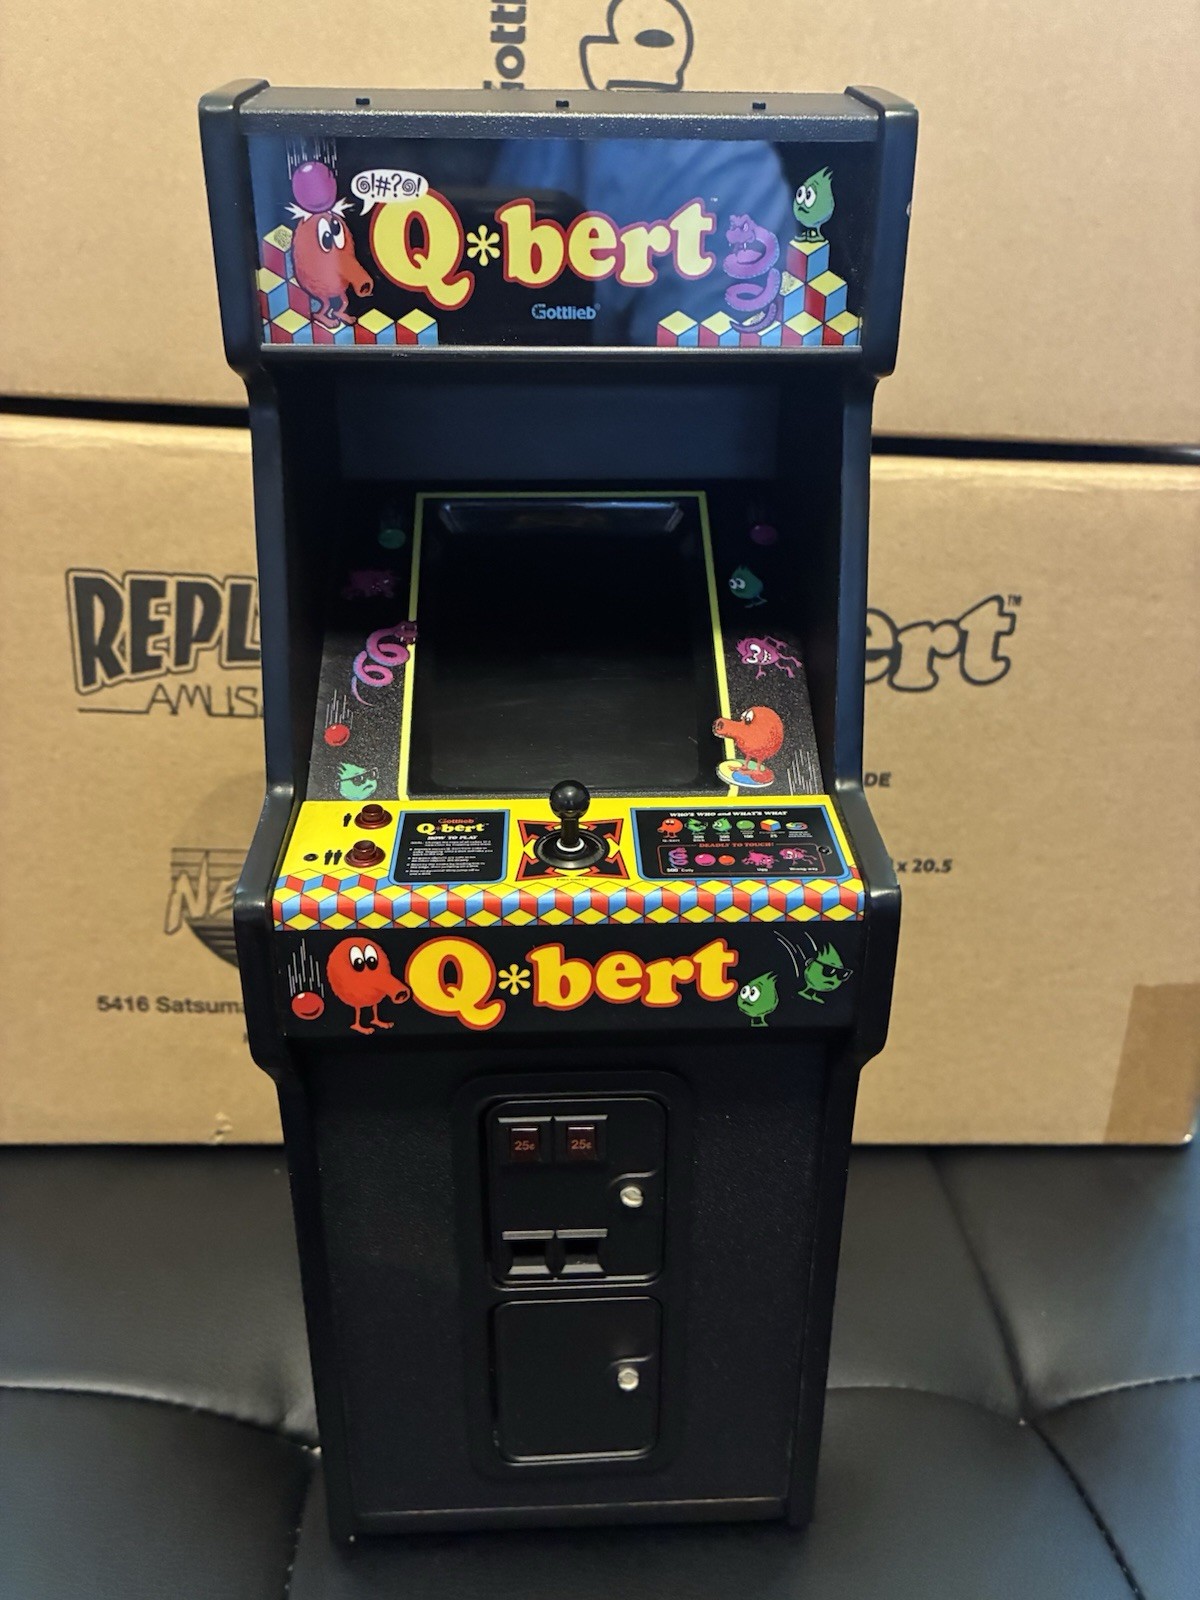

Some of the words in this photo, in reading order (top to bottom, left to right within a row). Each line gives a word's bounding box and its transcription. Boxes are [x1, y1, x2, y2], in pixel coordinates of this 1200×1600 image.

[531, 303, 597, 320] Gottlieb
[66, 567, 261, 696] REPL
[864, 595, 1017, 692] ert
[146, 683, 264, 718] AMUS
[912, 859, 952, 873] 20.5
[97, 996, 150, 1012] 5416
